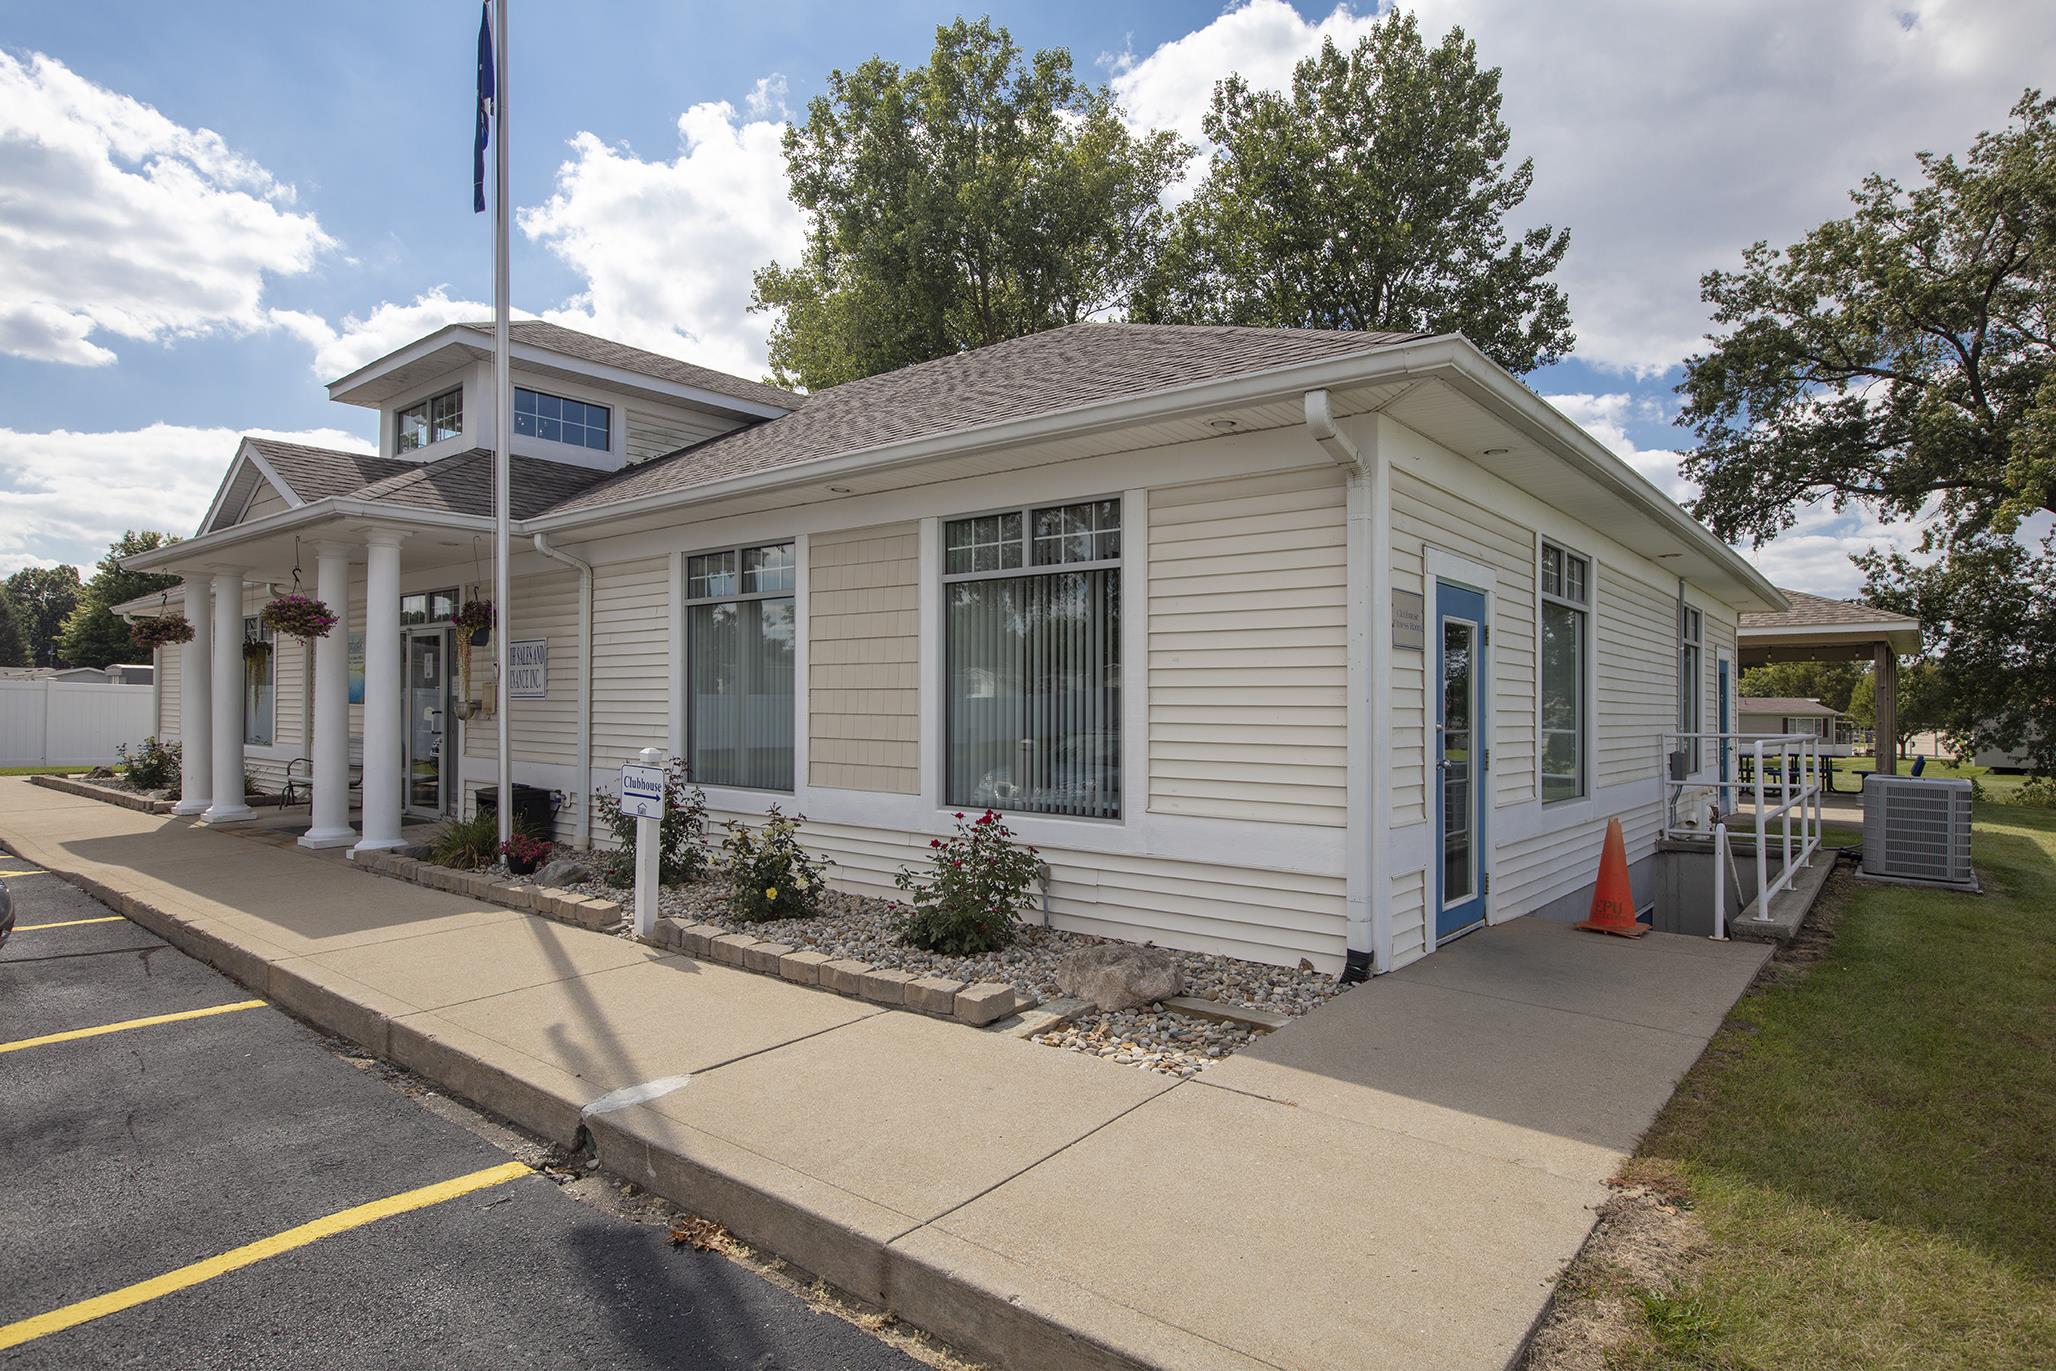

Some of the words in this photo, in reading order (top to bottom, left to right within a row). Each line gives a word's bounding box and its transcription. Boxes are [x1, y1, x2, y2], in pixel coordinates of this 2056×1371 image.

[516, 646, 532, 666] SALES
[533, 645, 544, 665] AND
[530, 669, 541, 688] INC.
[624, 775, 662, 792] Clubhouse
